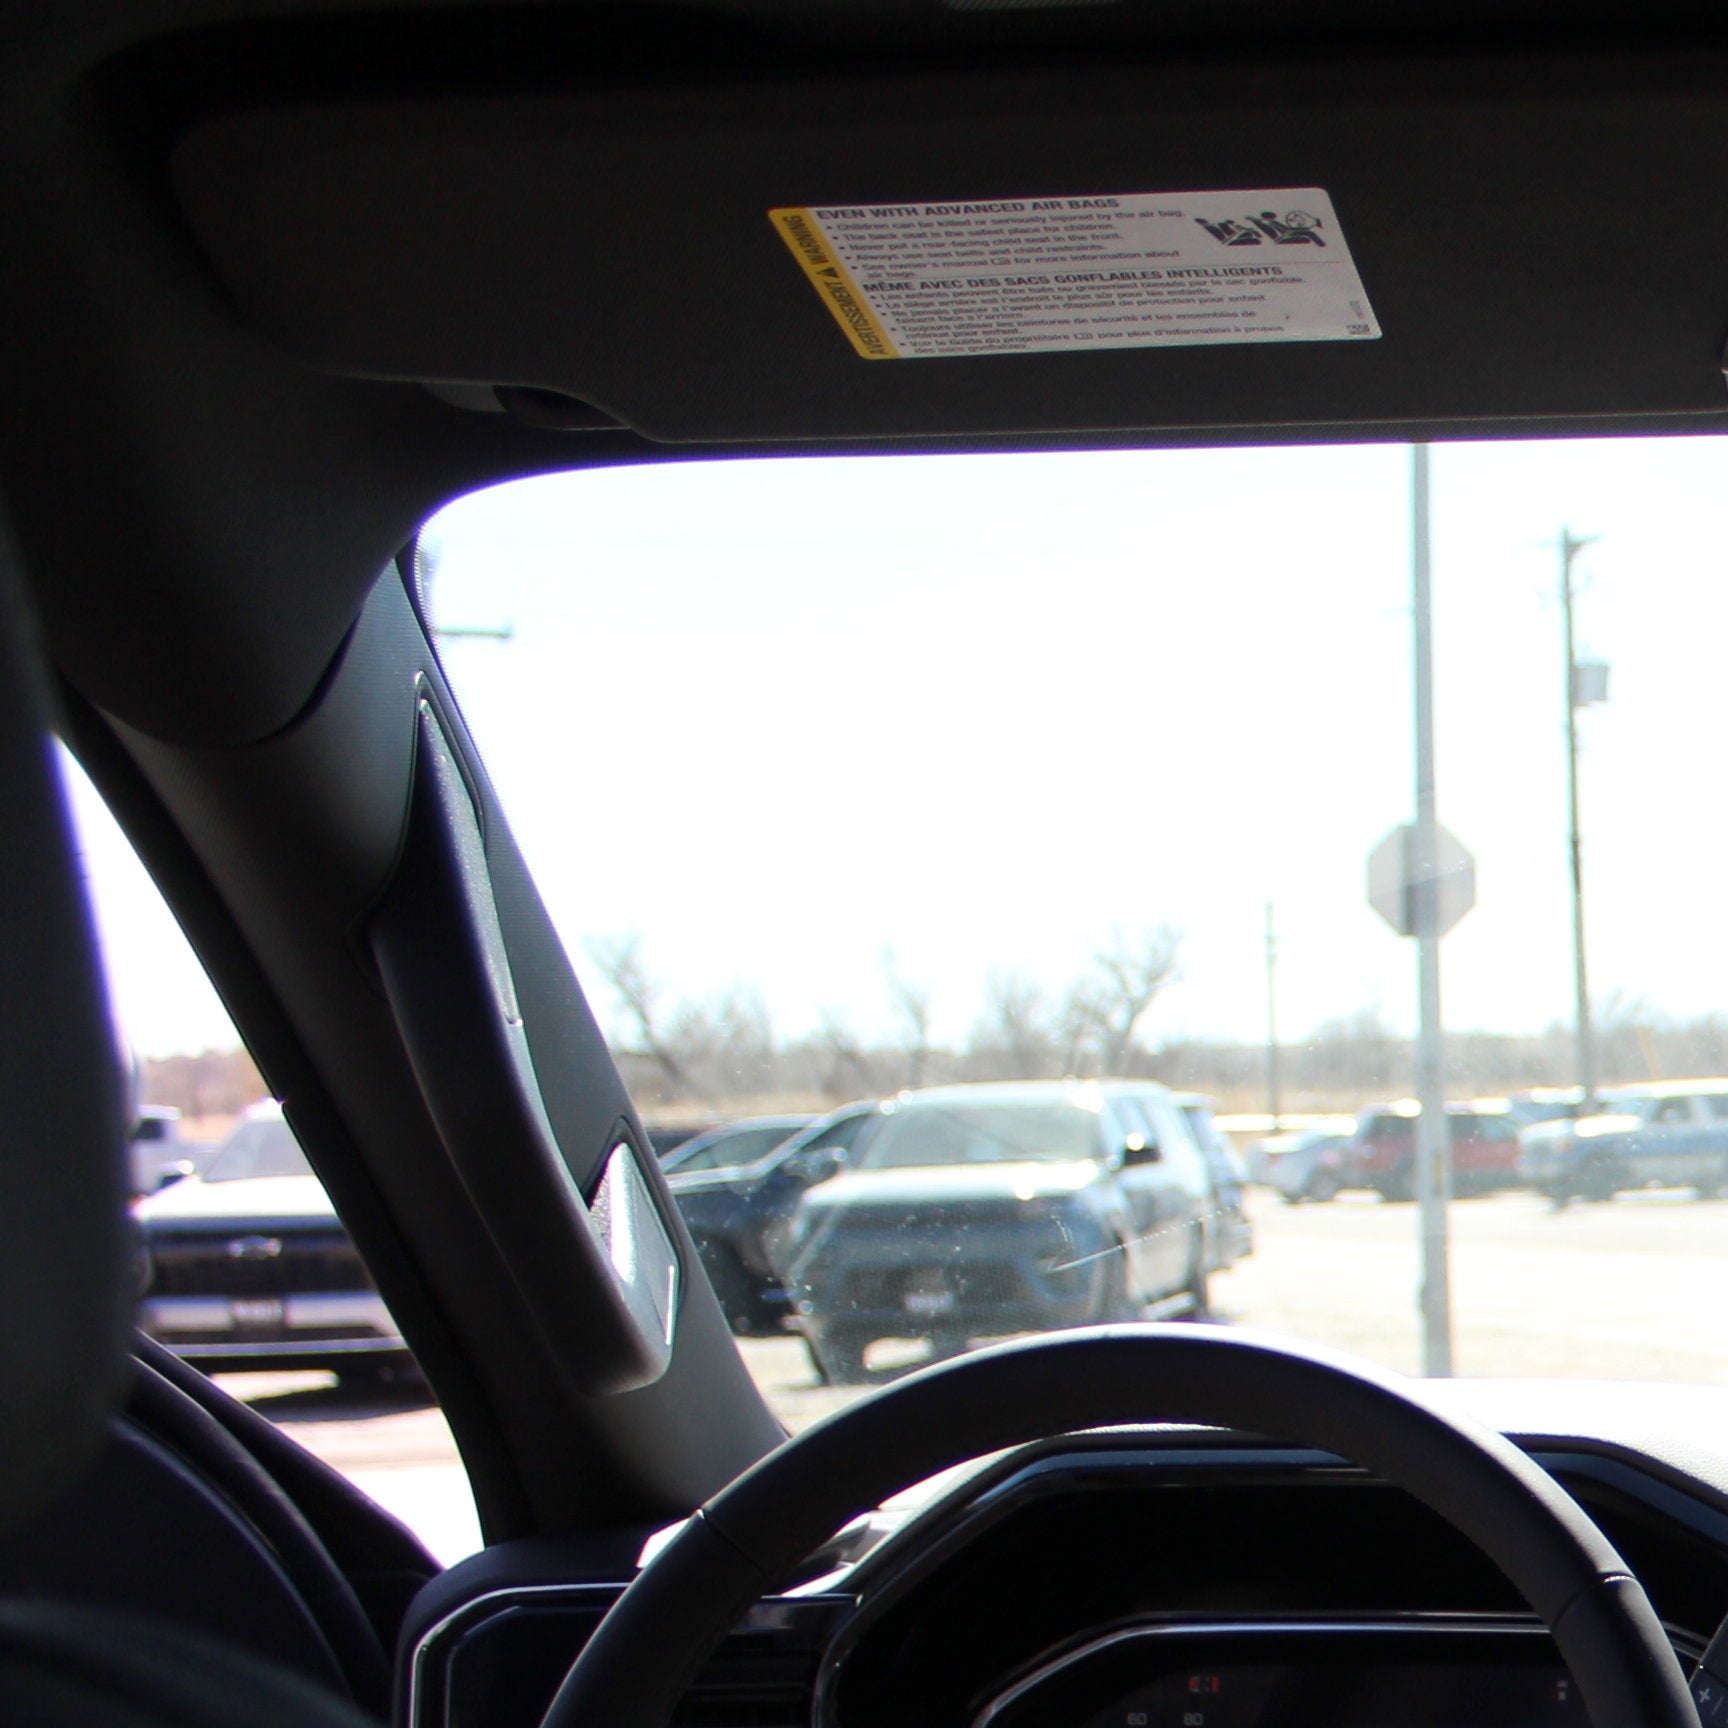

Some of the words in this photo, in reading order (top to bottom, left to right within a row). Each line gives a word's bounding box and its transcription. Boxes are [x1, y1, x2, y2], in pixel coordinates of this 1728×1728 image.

[815, 208, 866, 219] EVEN
[868, 206, 918, 217] WITH
[921, 201, 1026, 215] ADVANCED
[1029, 200, 1062, 210] AIR
[1067, 198, 1119, 209] BAGS
[782, 215, 828, 263] WARNING
[917, 279, 963, 289] AVEC
[966, 277, 1000, 287] DES
[1003, 275, 1050, 286] SACS
[1053, 270, 1162, 283] GONFLABLES
[1166, 265, 1282, 279] INTELLIGENTS
[825, 280, 886, 354] AVERTISSEMENT
[1183, 1713, 1204, 1727] 80
